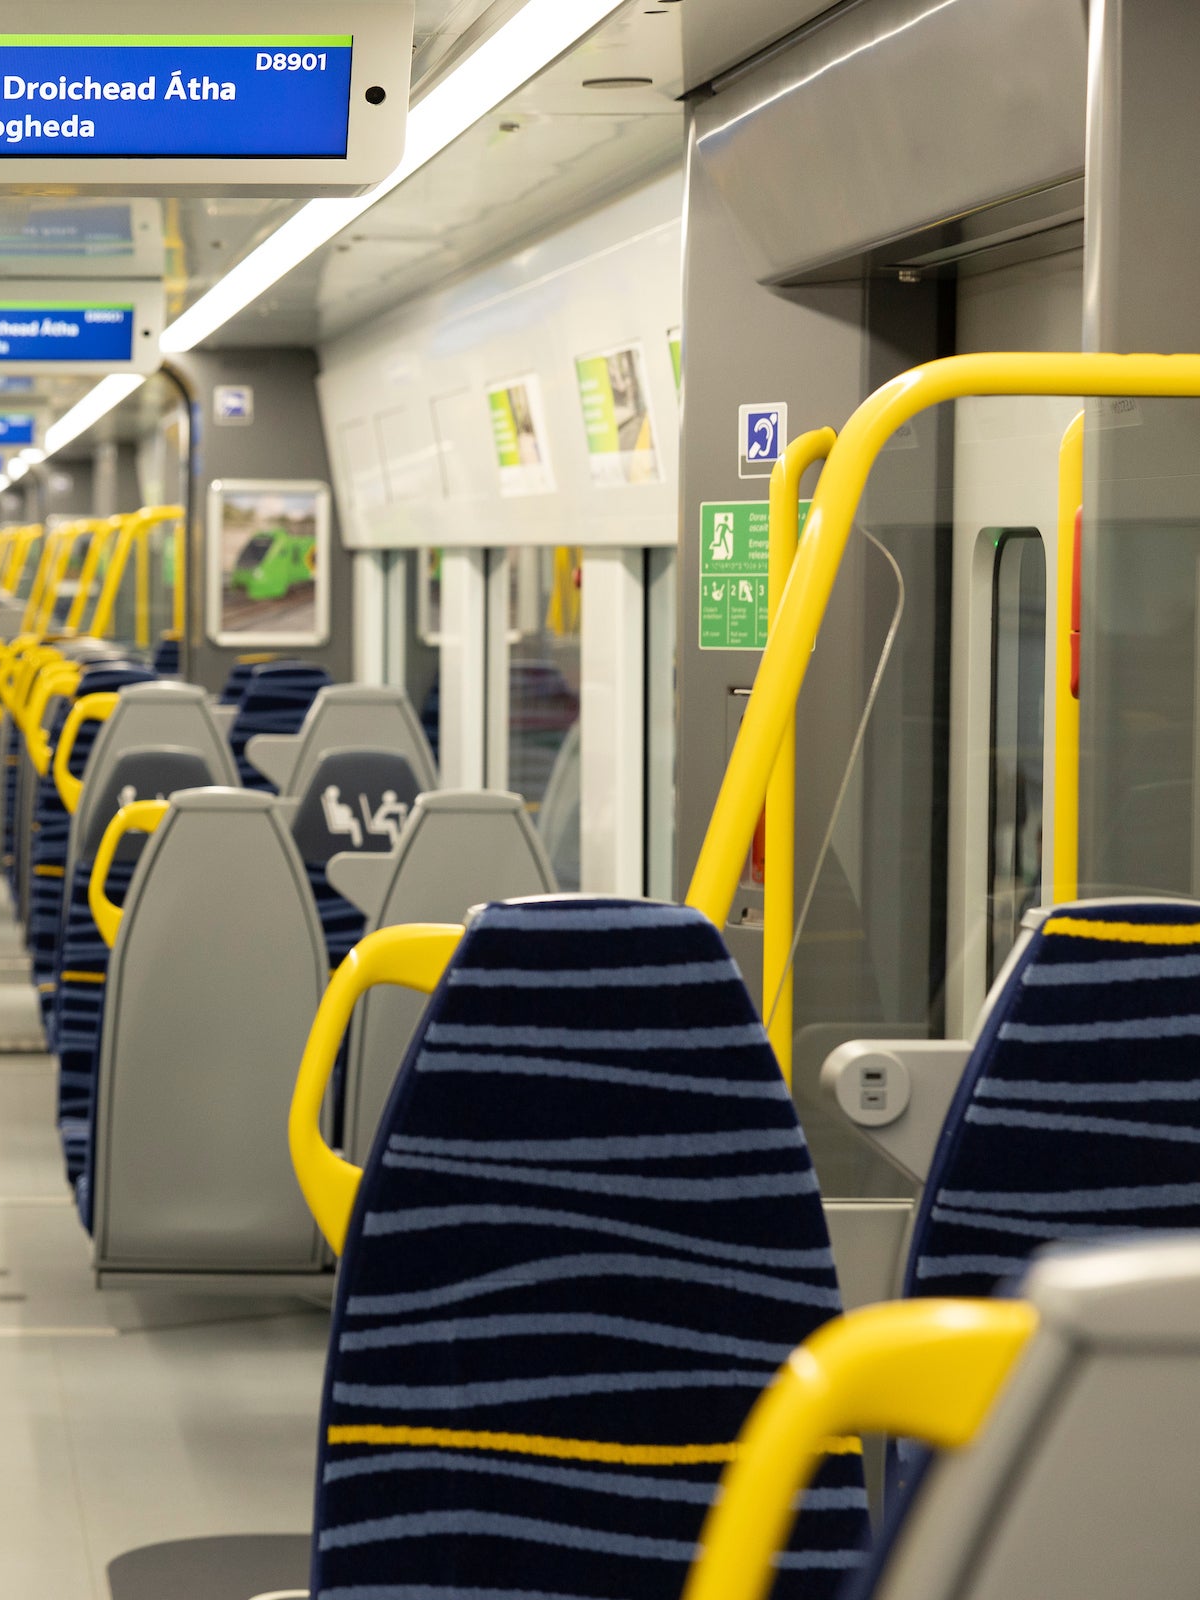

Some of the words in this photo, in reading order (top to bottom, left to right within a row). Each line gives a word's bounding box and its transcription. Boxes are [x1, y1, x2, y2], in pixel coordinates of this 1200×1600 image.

[255, 52, 327, 71] D8901
[3, 75, 156, 101] Droichead
[163, 68, 236, 101] Átha
[703, 585, 708, 596] 1
[730, 585, 737, 596] 2
[759, 585, 765, 596] 3
